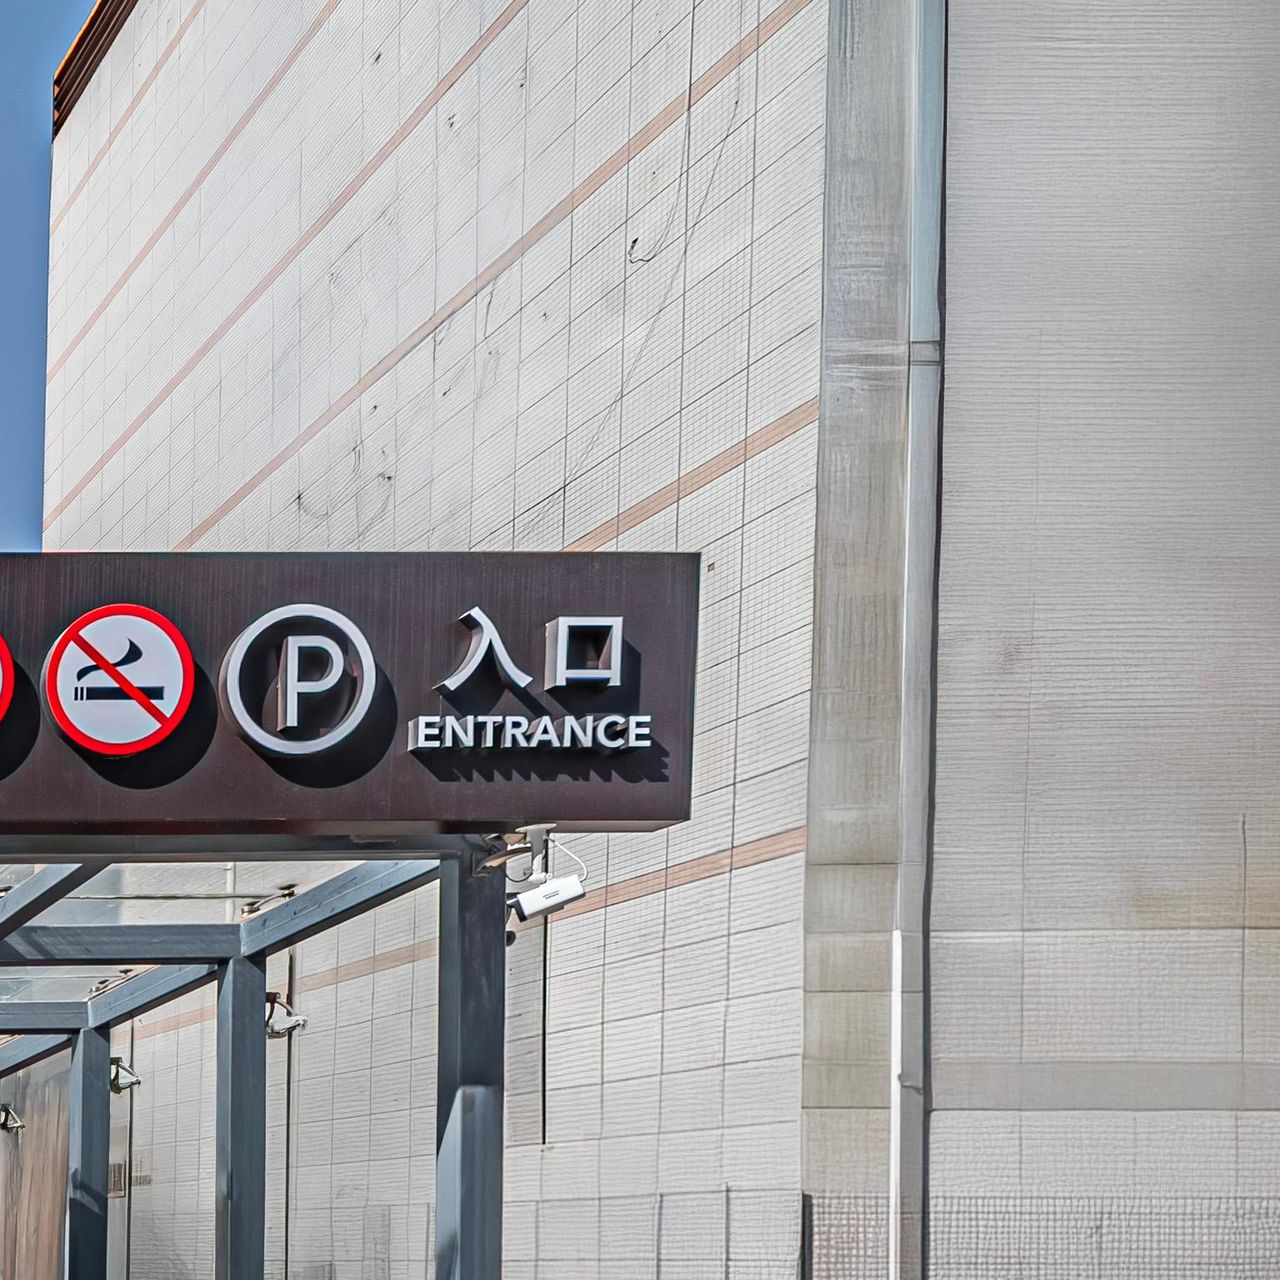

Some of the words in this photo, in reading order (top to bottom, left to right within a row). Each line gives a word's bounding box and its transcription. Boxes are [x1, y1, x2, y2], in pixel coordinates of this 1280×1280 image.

[285, 635, 344, 728] P
[437, 606, 623, 690] 入口
[416, 714, 652, 748] ENTRANCE
